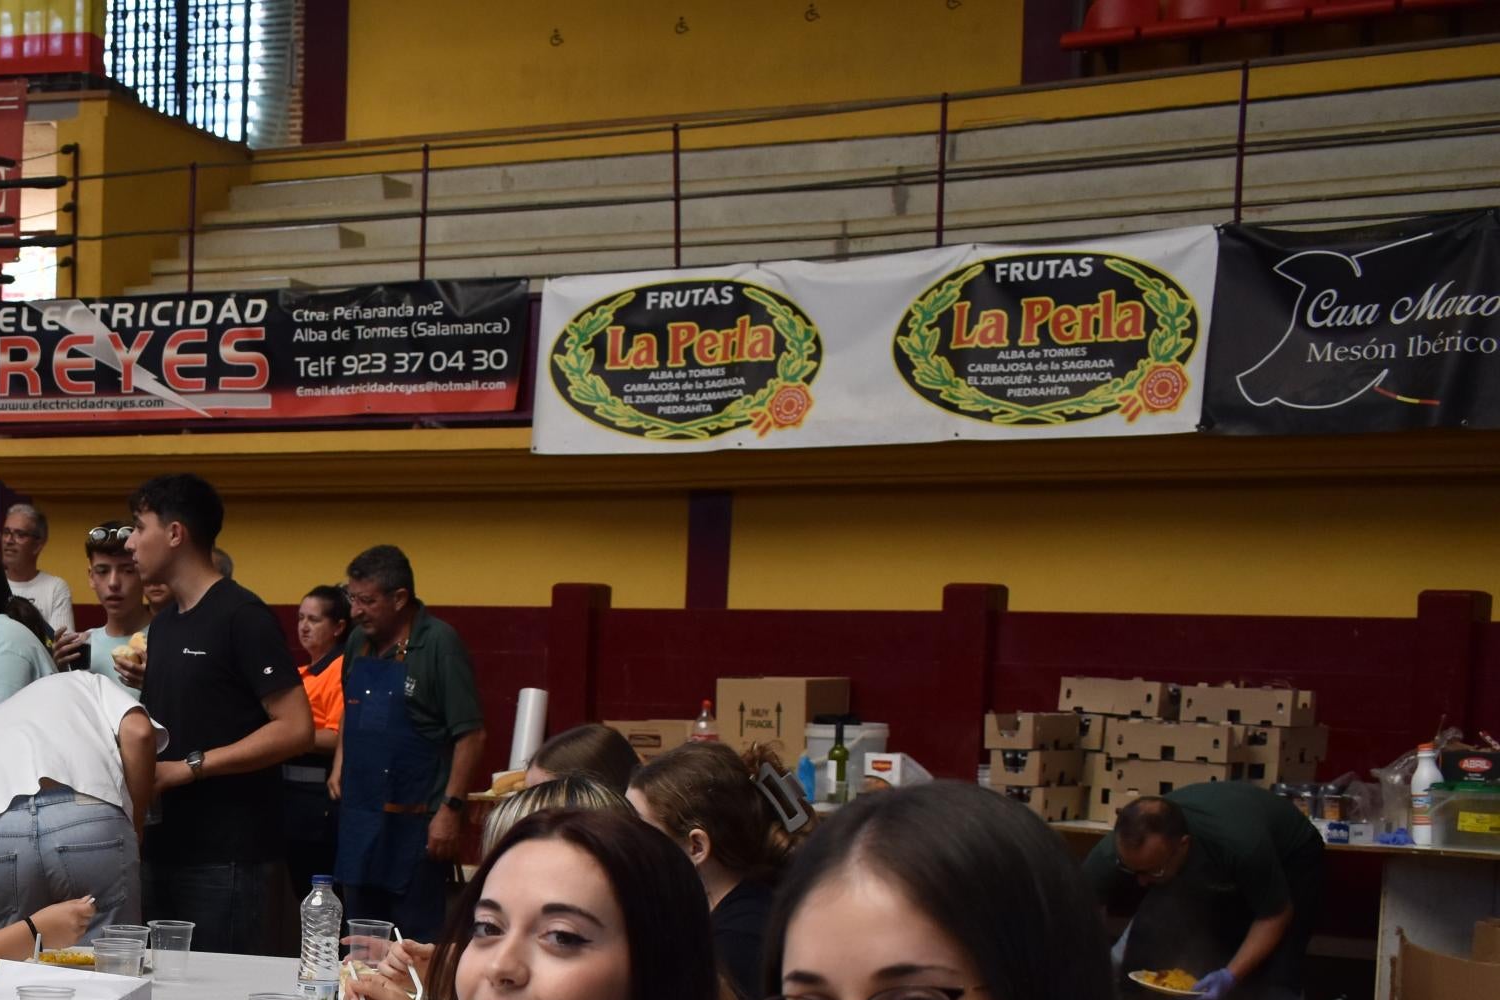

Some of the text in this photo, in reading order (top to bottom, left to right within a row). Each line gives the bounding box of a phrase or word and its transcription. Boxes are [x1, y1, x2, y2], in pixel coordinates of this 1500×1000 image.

[994, 256, 1094, 283] FRUTAS
[646, 285, 735, 310] FRUTAS
[1306, 287, 1381, 328] Casa
[292, 308, 329, 322] Ctra:
[333, 304, 414, 321] Peñaranda
[950, 289, 1147, 349] La Perla
[292, 317, 510, 343] Alba de Tormes (Salamanca)
[605, 314, 776, 370] La Perla
[1306, 330, 1498, 363] Mesón Ibérico
[294, 349, 508, 378] Telf 923 37 04 30
[997, 347, 1087, 360] ALBA de TORMES
[649, 367, 726, 380] ALBA de TORMES
[967, 358, 1115, 373] CARBAJOSA de la SAGRADA
[623, 377, 746, 392] CARBAJOSA de la SAGRADA
[967, 376, 981, 386] EL
[751, 708, 769, 717] MUY
[1462, 759, 1491, 769] ABRIL
